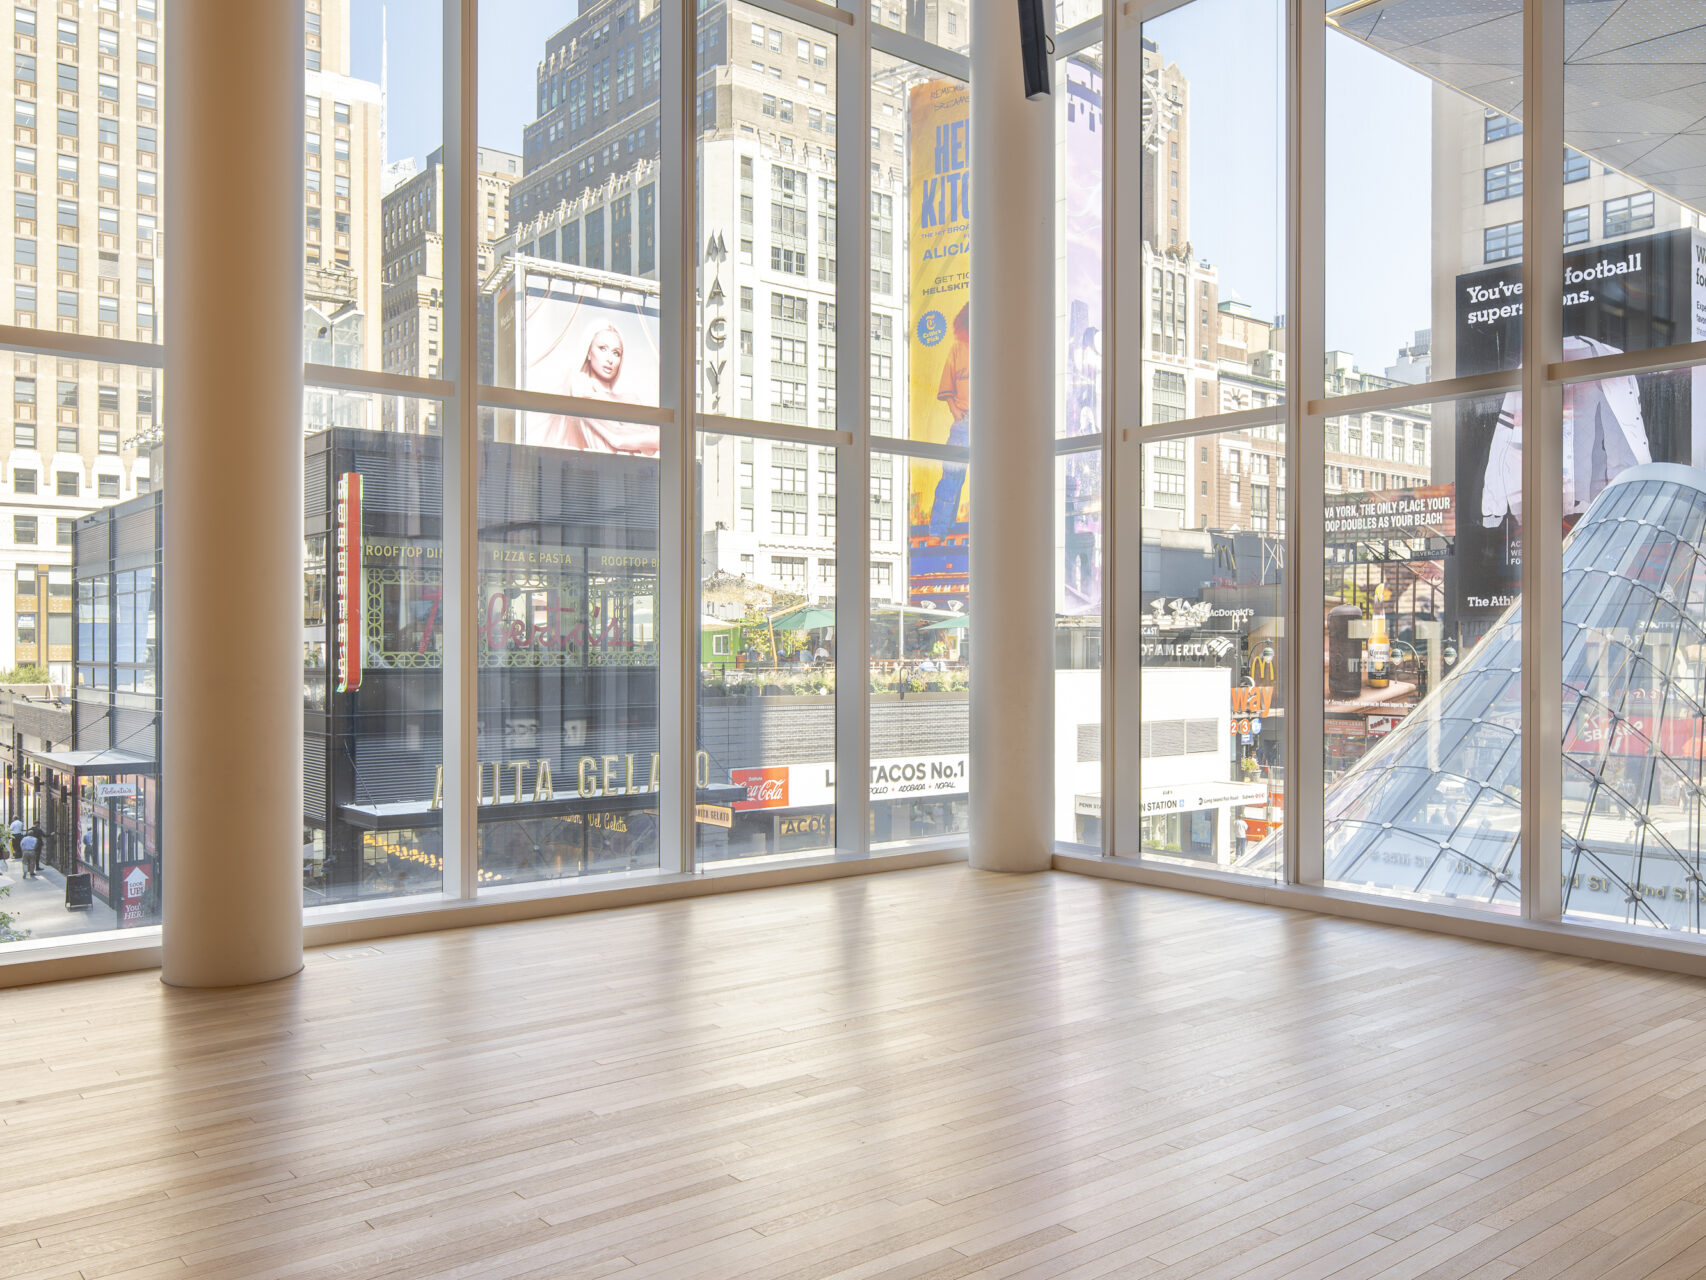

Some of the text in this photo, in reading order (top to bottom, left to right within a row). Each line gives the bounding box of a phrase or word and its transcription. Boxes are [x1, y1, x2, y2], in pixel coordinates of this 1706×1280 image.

[1696, 245, 1706, 264] W
[1564, 252, 1642, 285] football
[1696, 267, 1706, 287] fo
[934, 274, 954, 285] GET
[706, 229, 728, 414] MACY'
[1336, 505, 1358, 518] YORK,
[1360, 503, 1375, 516] THE
[1377, 501, 1397, 514] ONLY
[1399, 499, 1425, 512] PLACE
[1428, 497, 1450, 510] YOUR
[1341, 518, 1376, 531] DOUBLES
[1378, 516, 1389, 528] AS
[1391, 514, 1413, 527] YOUR
[1414, 512, 1443, 525] BEACH
[366, 545, 423, 558] ROOFTOP
[493, 550, 572, 564] PIZZA & PASTA
[601, 555, 659, 568] ROOFTOP B
[1468, 597, 1490, 607] The
[1154, 643, 1209, 656] AMERICA
[1231, 685, 1274, 718] way
[931, 760, 965, 780] No.1
[432, 750, 709, 810] AITA GELAO
[935, 782, 956, 790] NOPAL
[1147, 800, 1178, 812] STATION
[604, 812, 628, 833] Gelato
[711, 810, 730, 822] GELATO
[1588, 875, 1609, 892] St
[124, 910, 145, 921] HER
